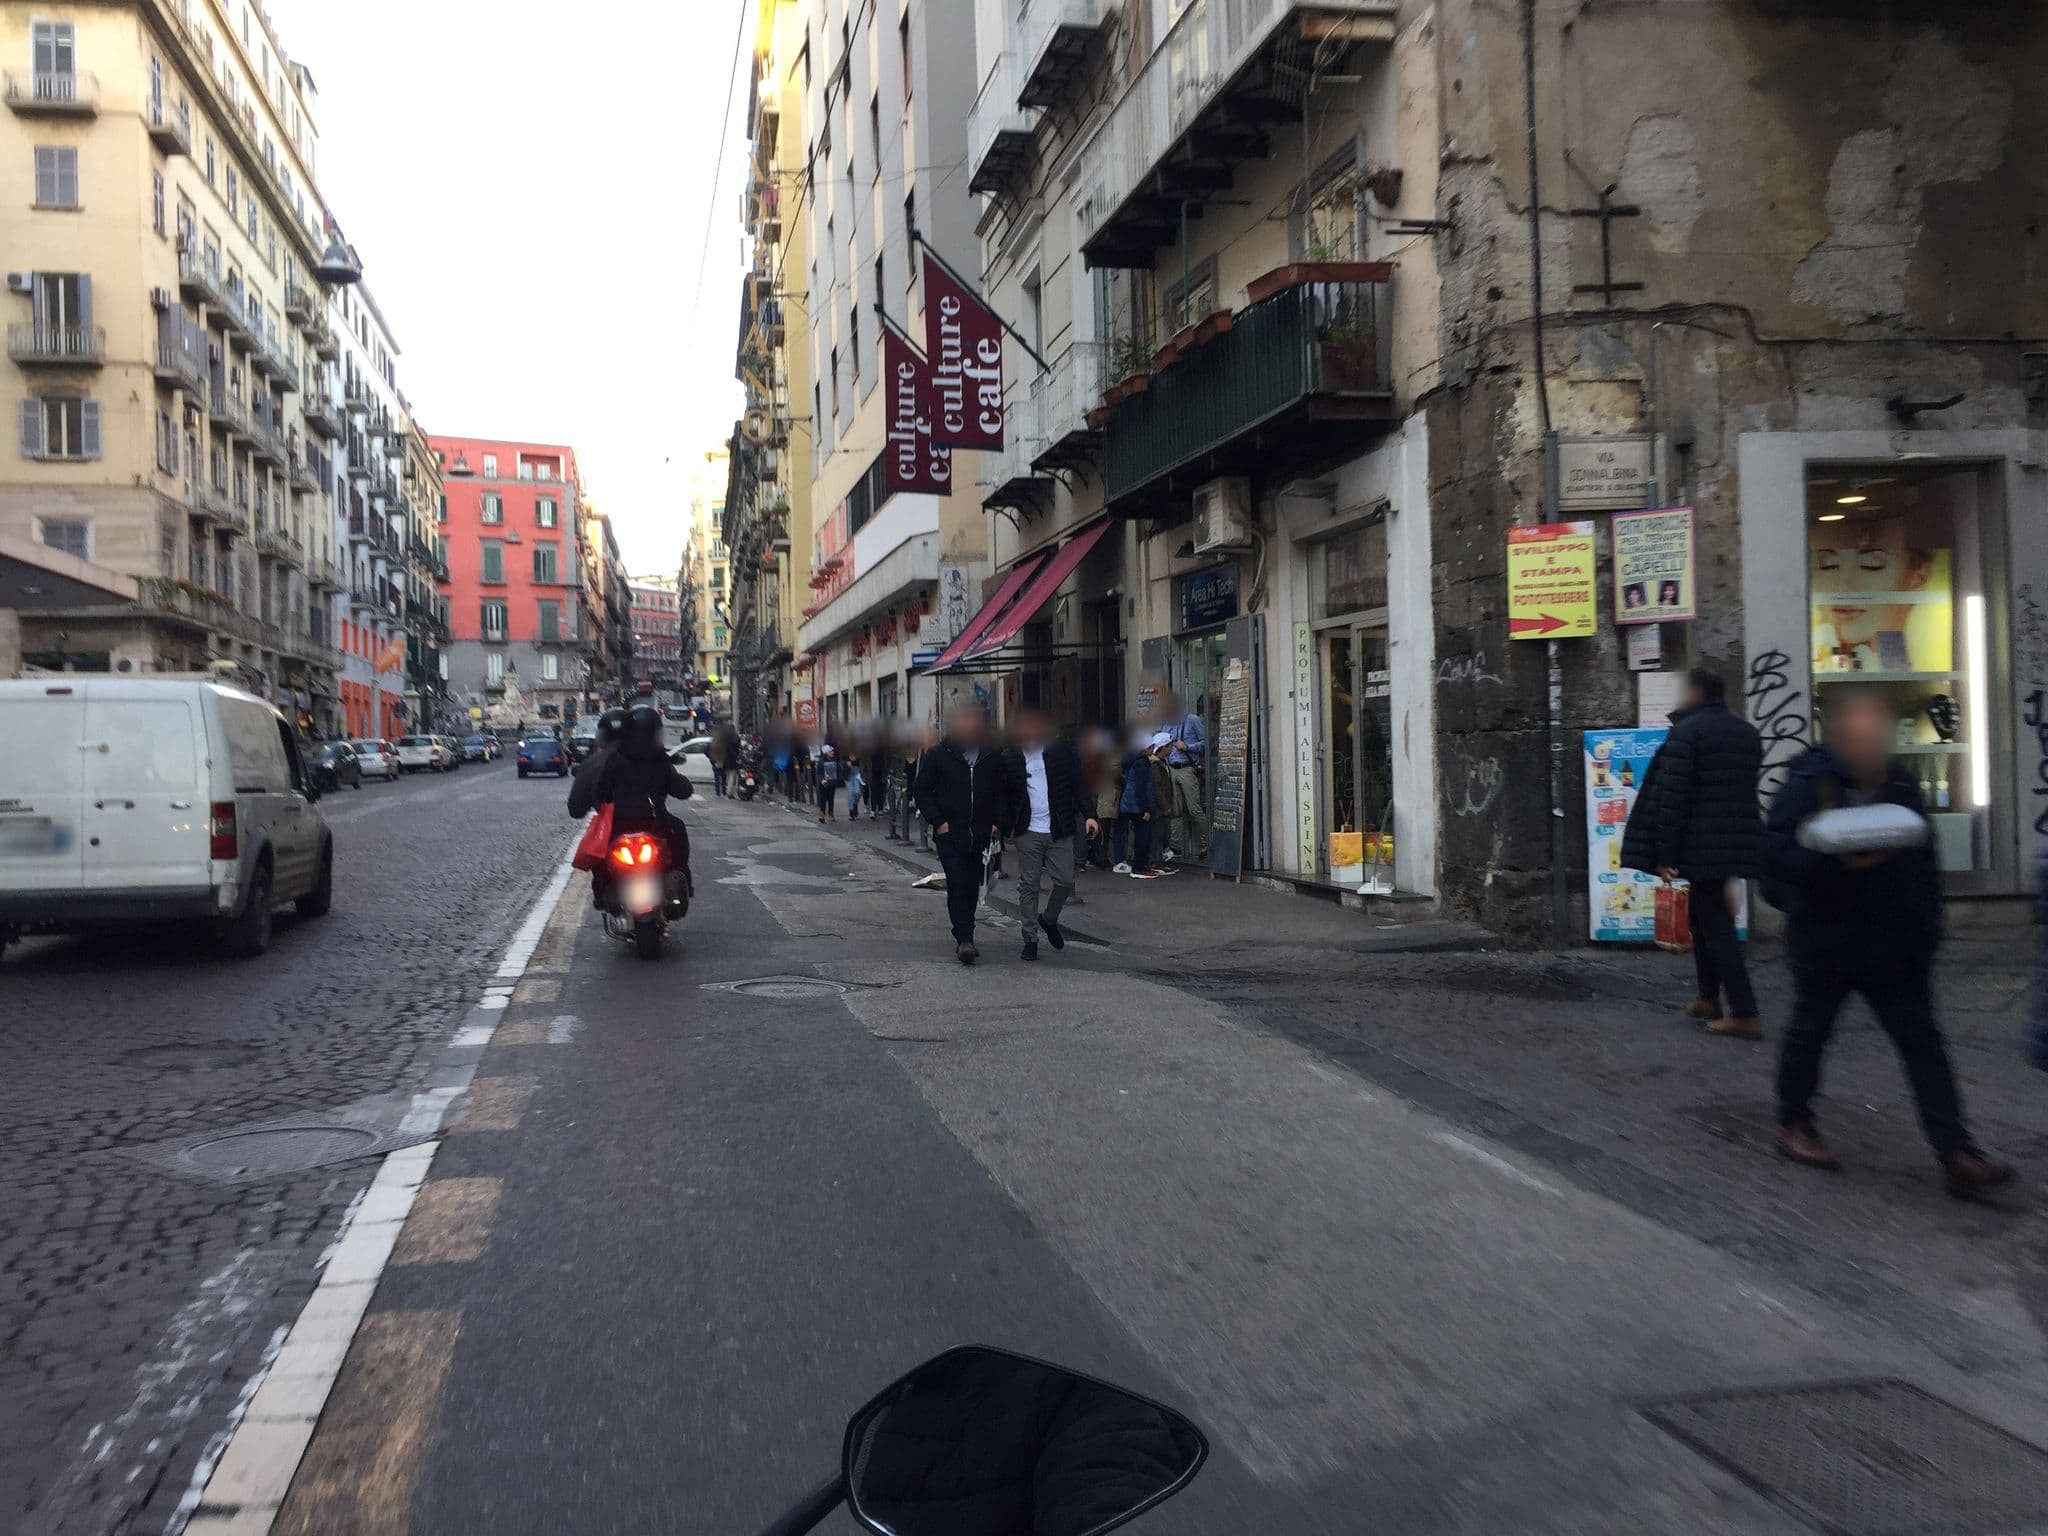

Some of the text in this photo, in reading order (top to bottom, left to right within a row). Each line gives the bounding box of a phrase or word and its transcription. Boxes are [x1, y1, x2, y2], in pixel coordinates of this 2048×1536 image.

[932, 295, 963, 434] culture
[962, 337, 1002, 435] cafe
[888, 361, 917, 480] culture
[1512, 543, 1589, 556] SVILUPPO
[1621, 537, 1640, 546] PER
[1546, 556, 1556, 565] E
[1621, 560, 1686, 575] CAPELLI
[1520, 566, 1583, 578] STAMPA
[1190, 587, 1207, 603] Area
[1216, 576, 1234, 597] Tech
[1299, 629, 1313, 870] PROFUMI ALLA SPINA
